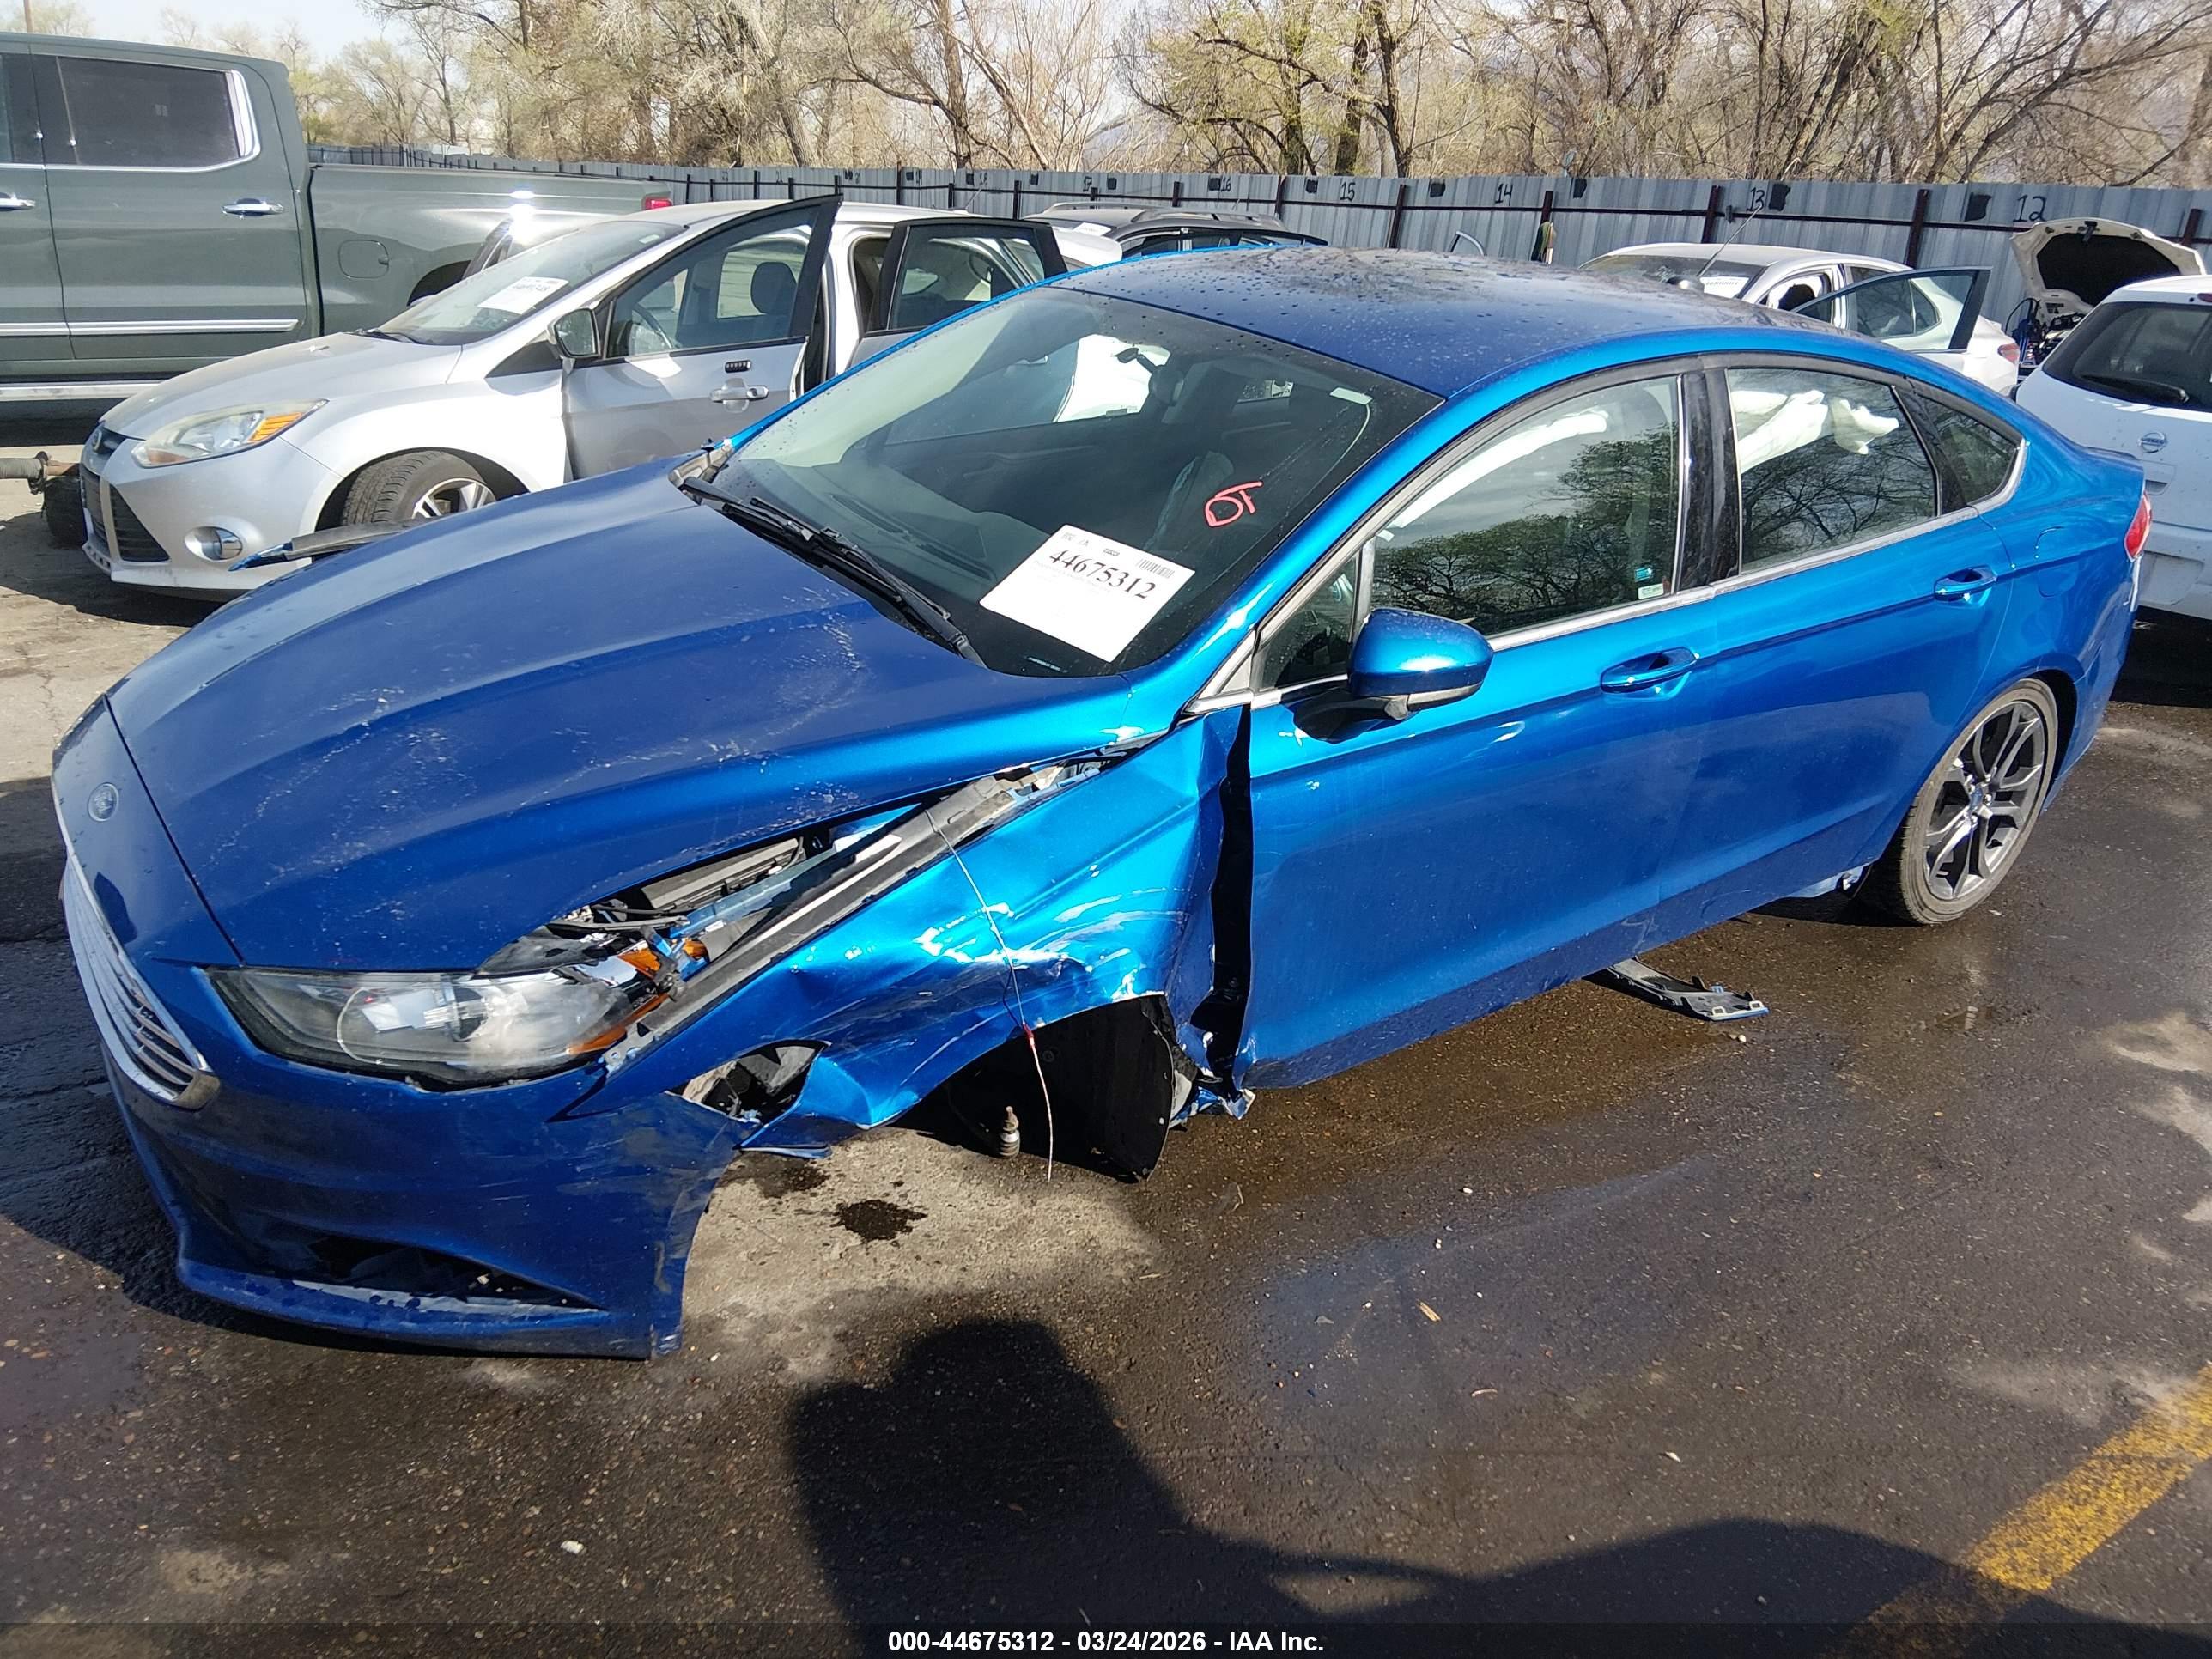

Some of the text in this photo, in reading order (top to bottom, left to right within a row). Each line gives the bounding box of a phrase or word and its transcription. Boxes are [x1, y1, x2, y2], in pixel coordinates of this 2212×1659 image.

[1221, 177, 1231, 192] 16
[1340, 181, 1356, 202] 15
[1494, 183, 1514, 206] 14
[1746, 186, 1765, 212] 13
[2012, 194, 2048, 222] 12
[1049, 550, 1157, 599] 44675312
